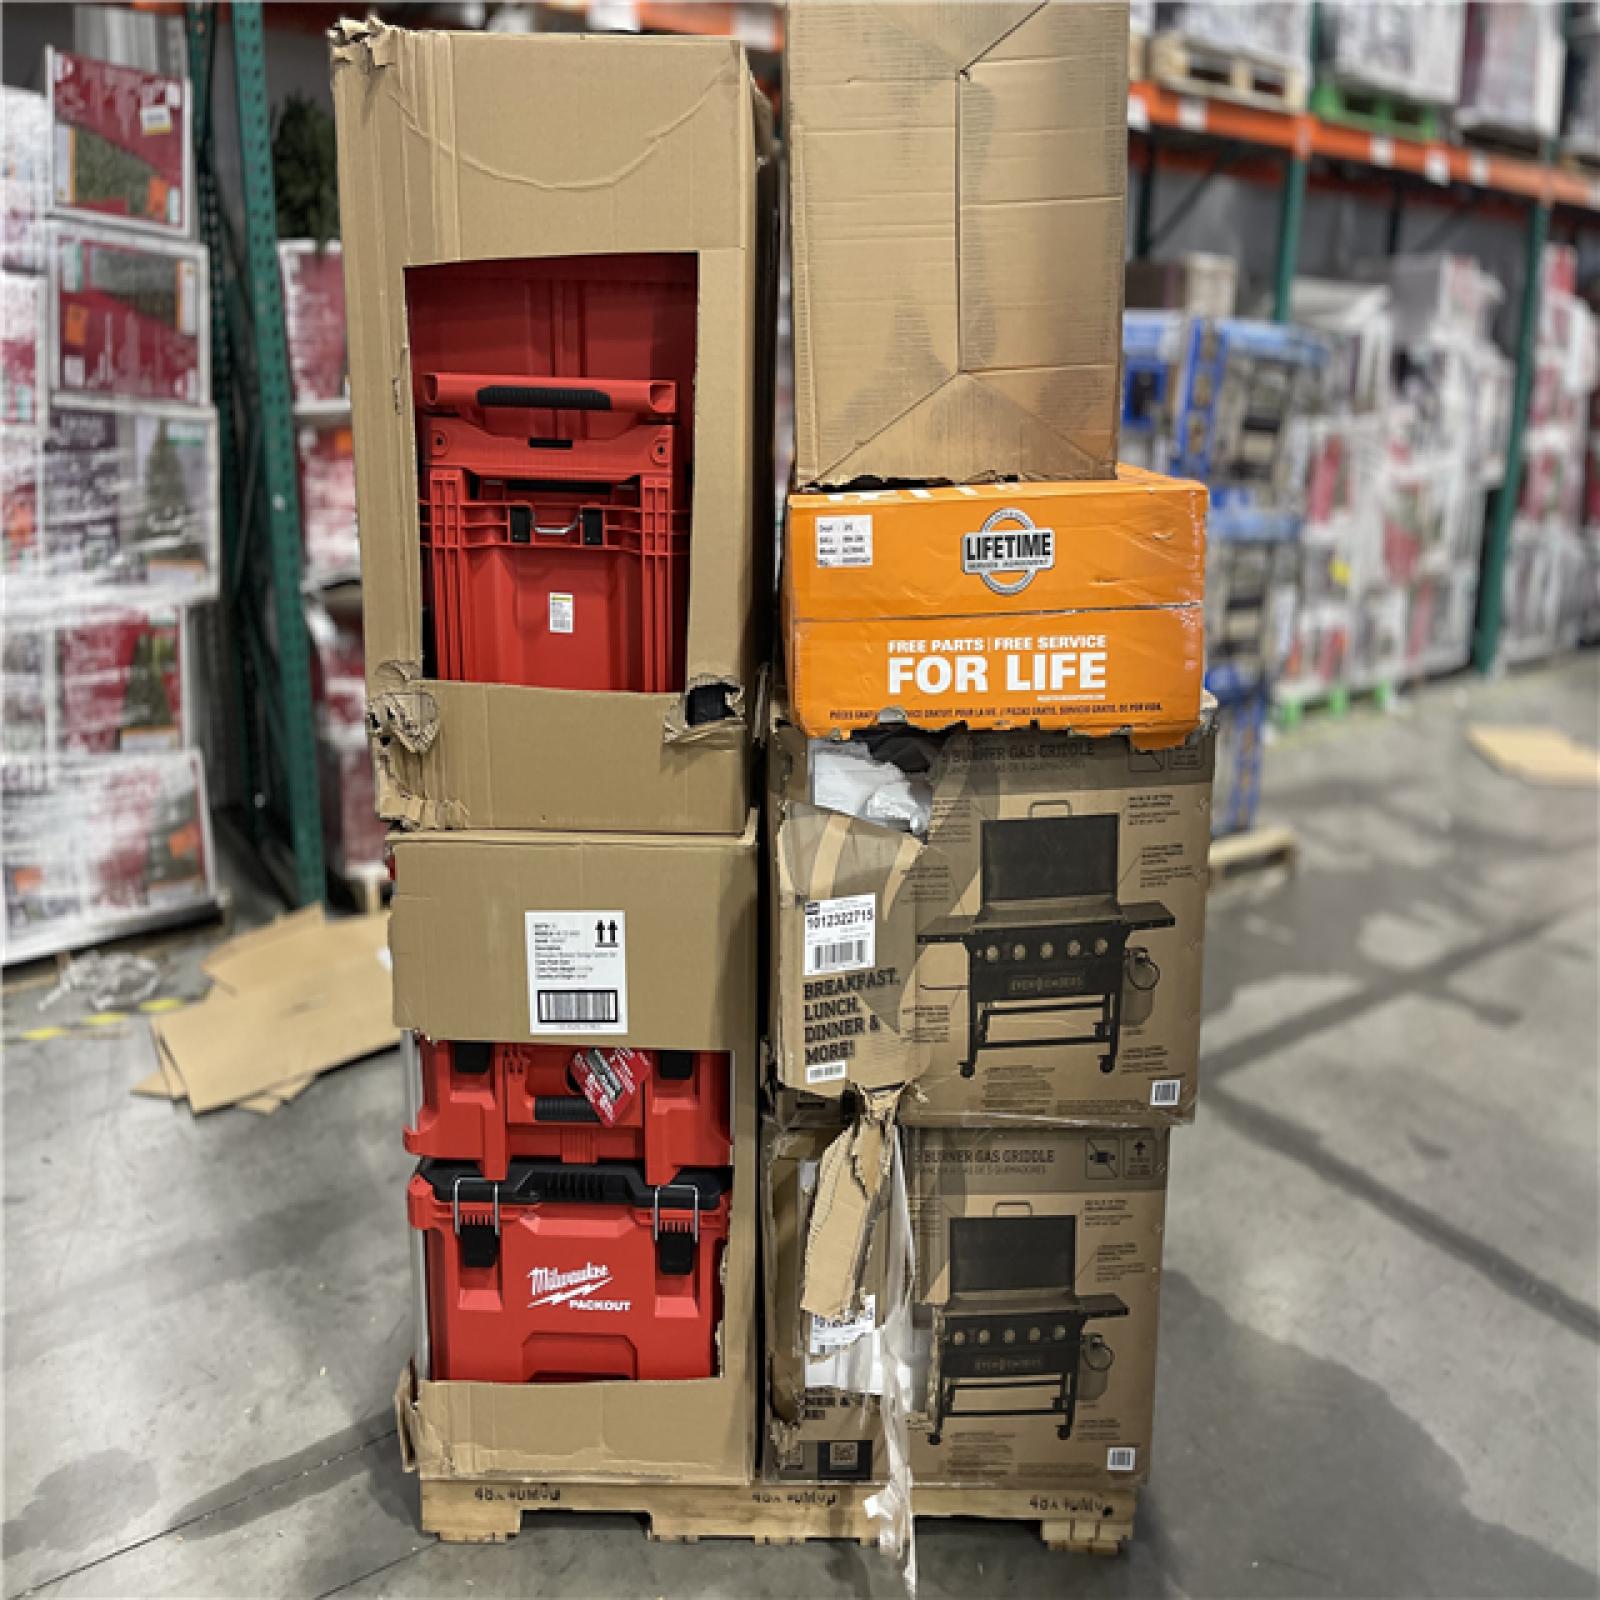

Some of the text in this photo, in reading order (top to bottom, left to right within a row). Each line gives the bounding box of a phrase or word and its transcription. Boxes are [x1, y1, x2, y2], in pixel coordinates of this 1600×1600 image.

[966, 532, 1052, 560] LIFETIME
[888, 635, 1106, 653] FREE PARTS FREE SERVICE
[888, 652, 1107, 693] FOR LIFE
[1040, 742, 1095, 758] GRIDDLE
[804, 1017, 864, 1043] DINNER
[869, 1014, 880, 1032] &
[804, 1039, 855, 1066] MORE!
[975, 1149, 1000, 1163] GAS
[1003, 1149, 1056, 1163] GRIDDLE
[569, 1299, 631, 1312] PACKOUT
